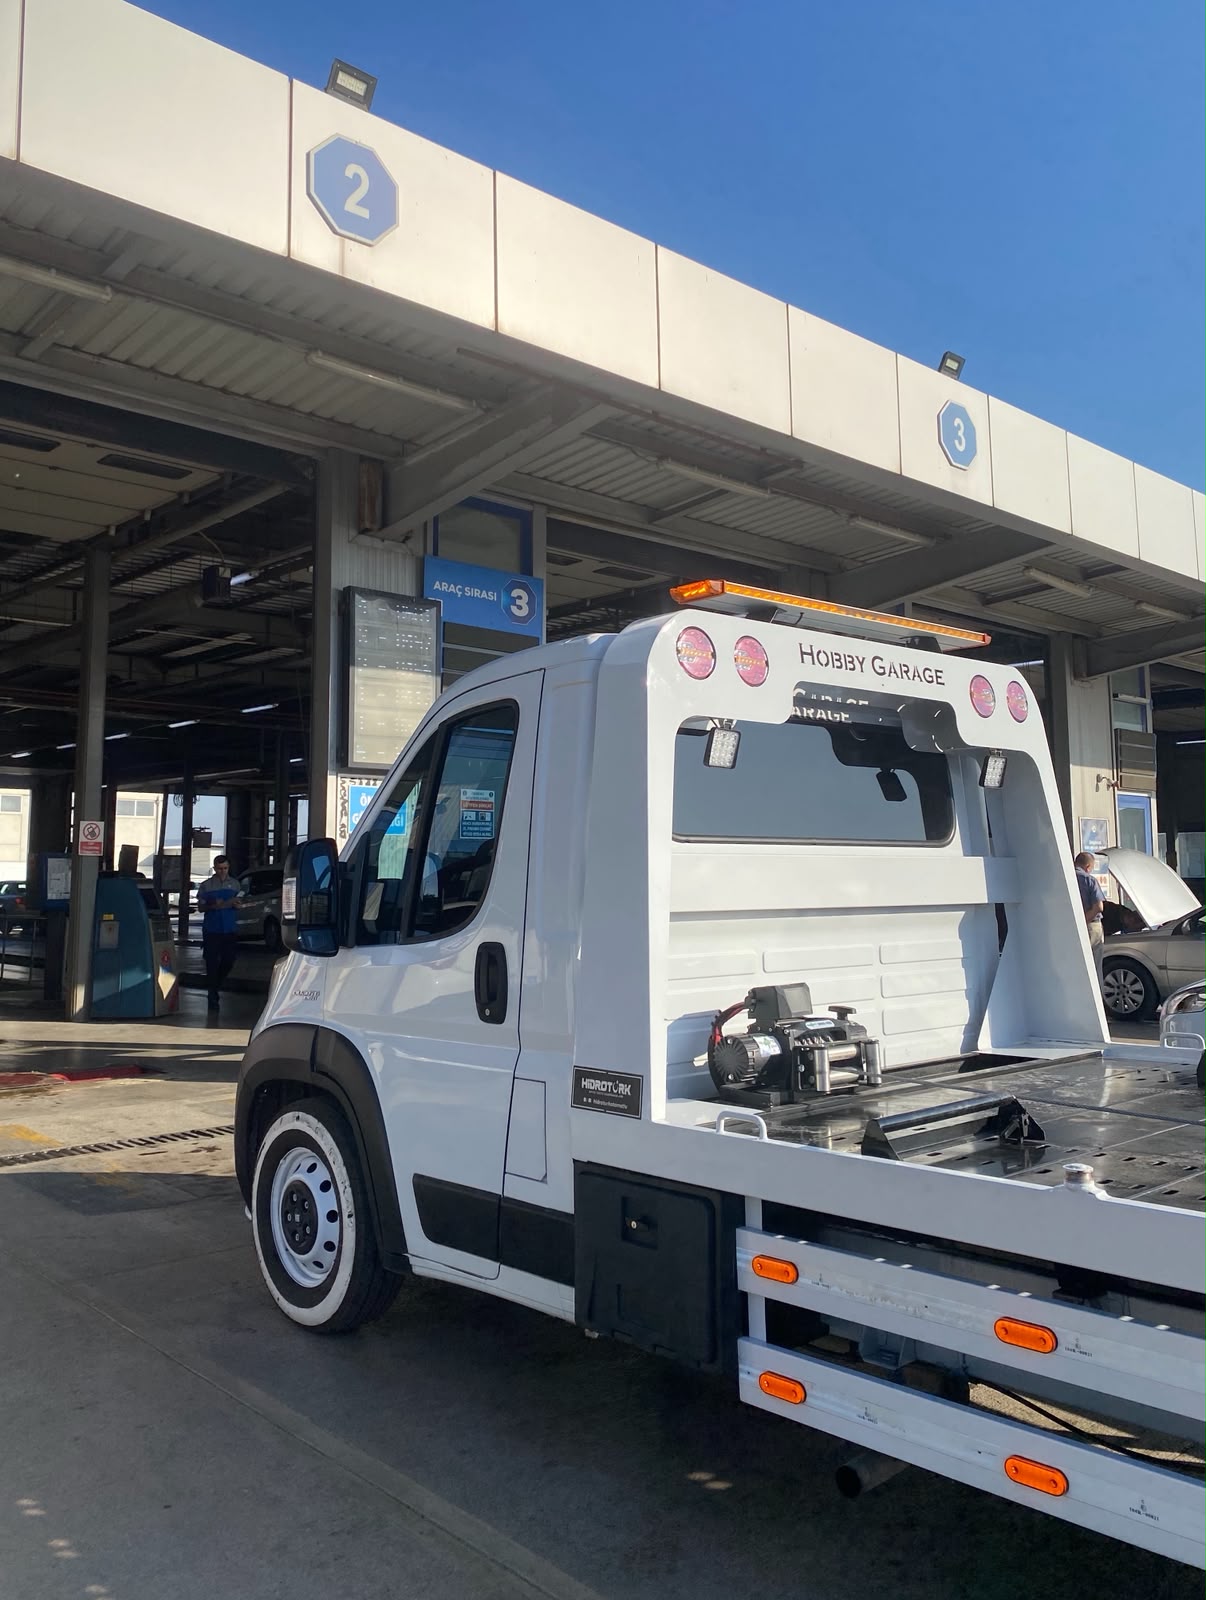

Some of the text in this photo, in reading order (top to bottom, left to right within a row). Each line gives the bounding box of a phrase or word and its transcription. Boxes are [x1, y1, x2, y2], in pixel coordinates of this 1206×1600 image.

[343, 162, 370, 220] 2
[953, 417, 966, 452] 3
[433, 581, 497, 602] ARAÇ SIRASI
[510, 588, 529, 617] 3
[798, 642, 946, 687] HOBBY GARAGE
